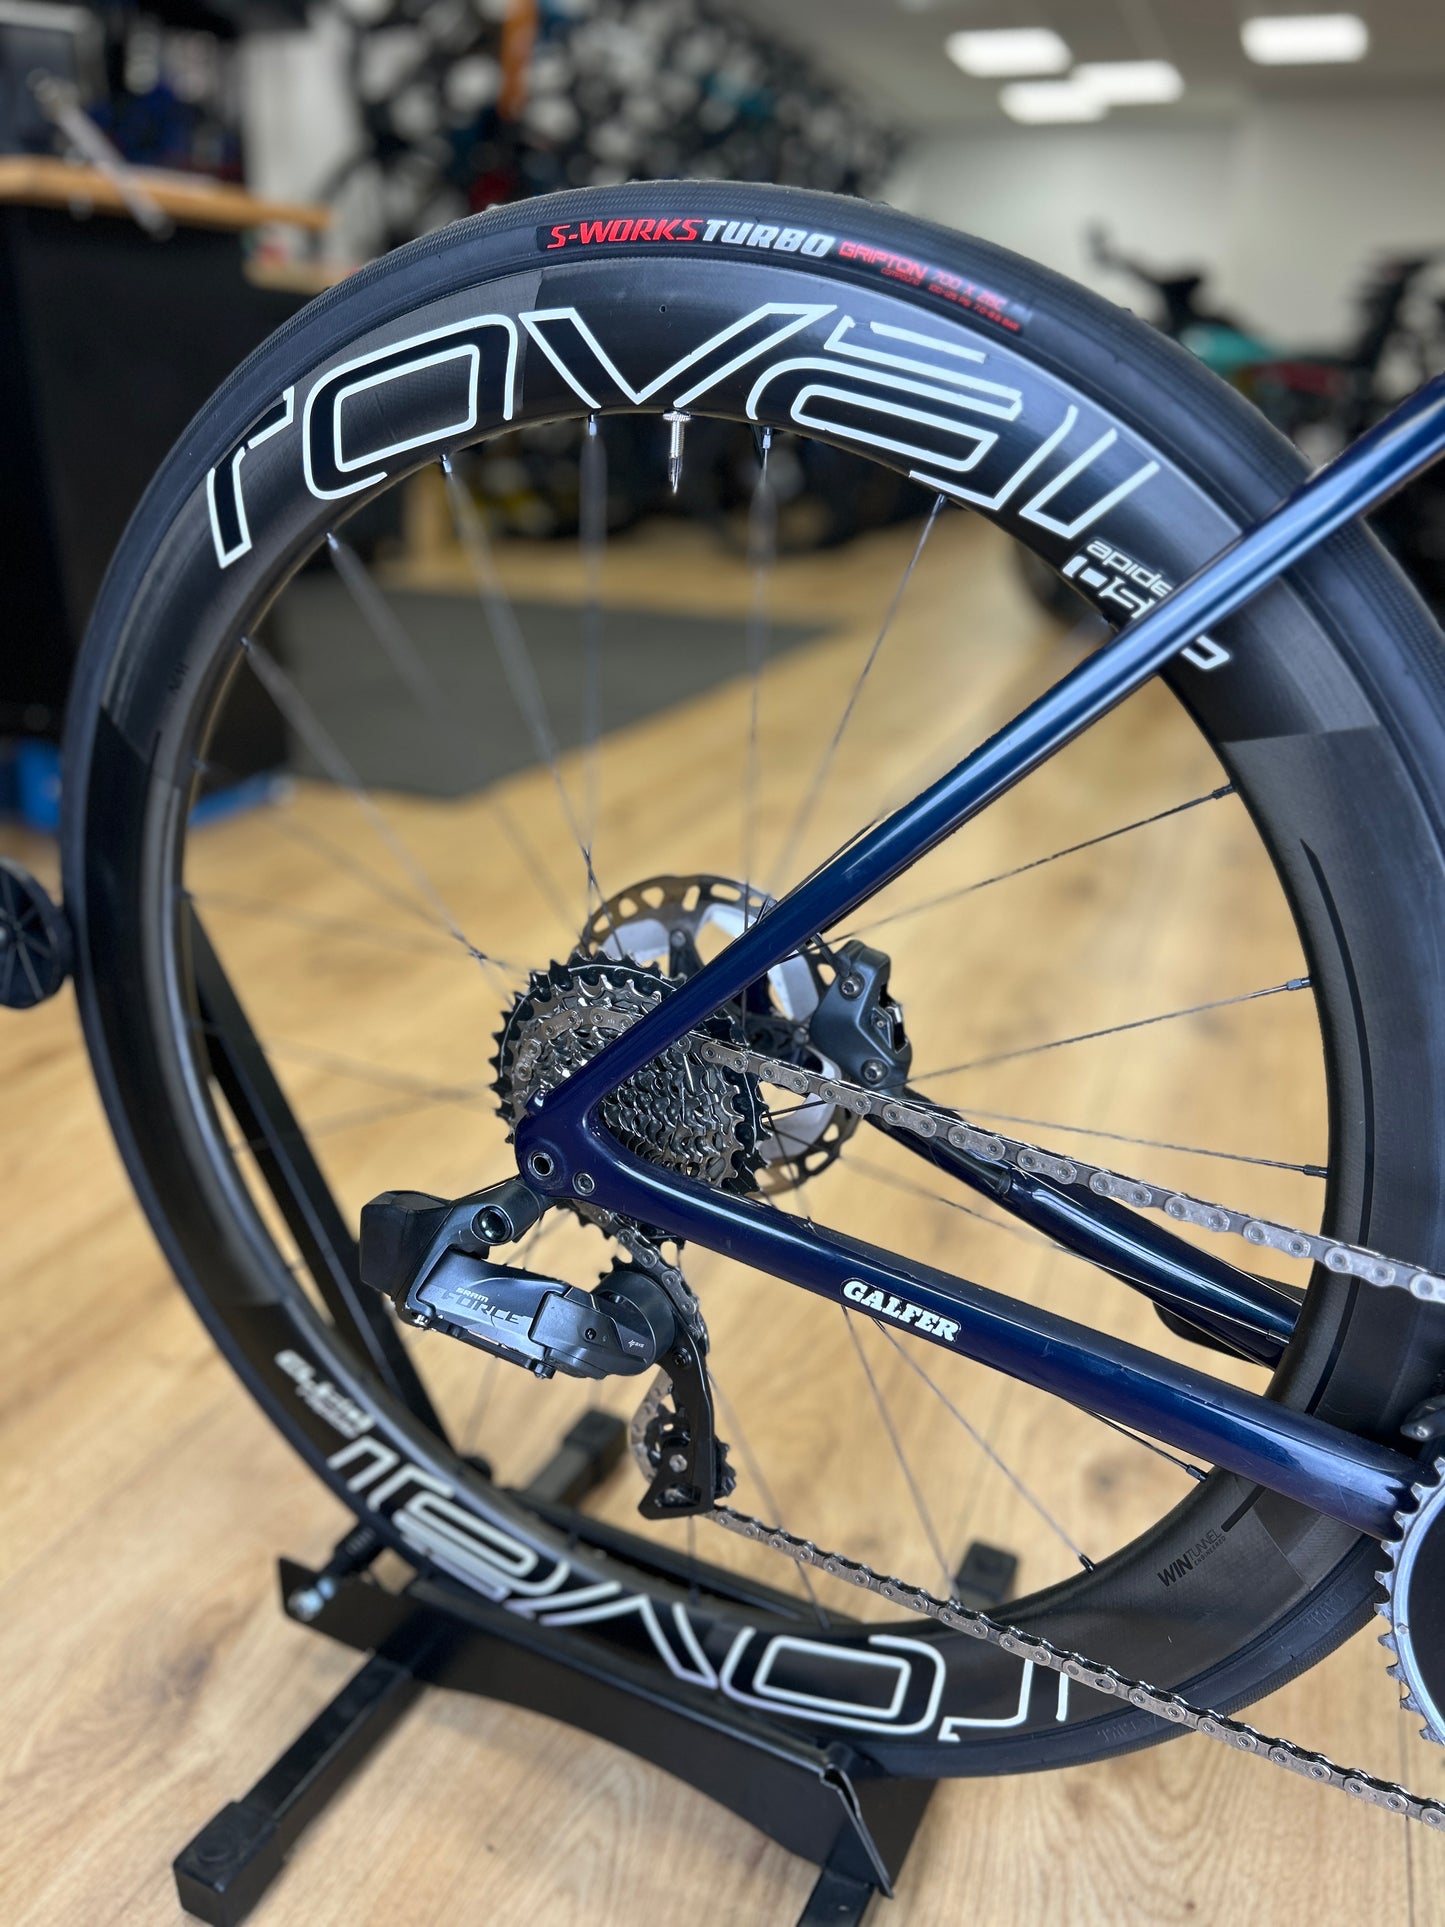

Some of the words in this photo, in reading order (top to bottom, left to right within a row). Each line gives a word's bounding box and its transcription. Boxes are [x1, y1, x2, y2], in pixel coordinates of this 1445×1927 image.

[547, 218, 704, 250] S-WORKS
[702, 219, 837, 258] TURBO
[838, 241, 928, 280] GRIPTON
[932, 269, 963, 290] 700
[440, 1289, 520, 1325] FORCE
[455, 1286, 490, 1304] SRAM
[843, 1280, 961, 1343] GALFER
